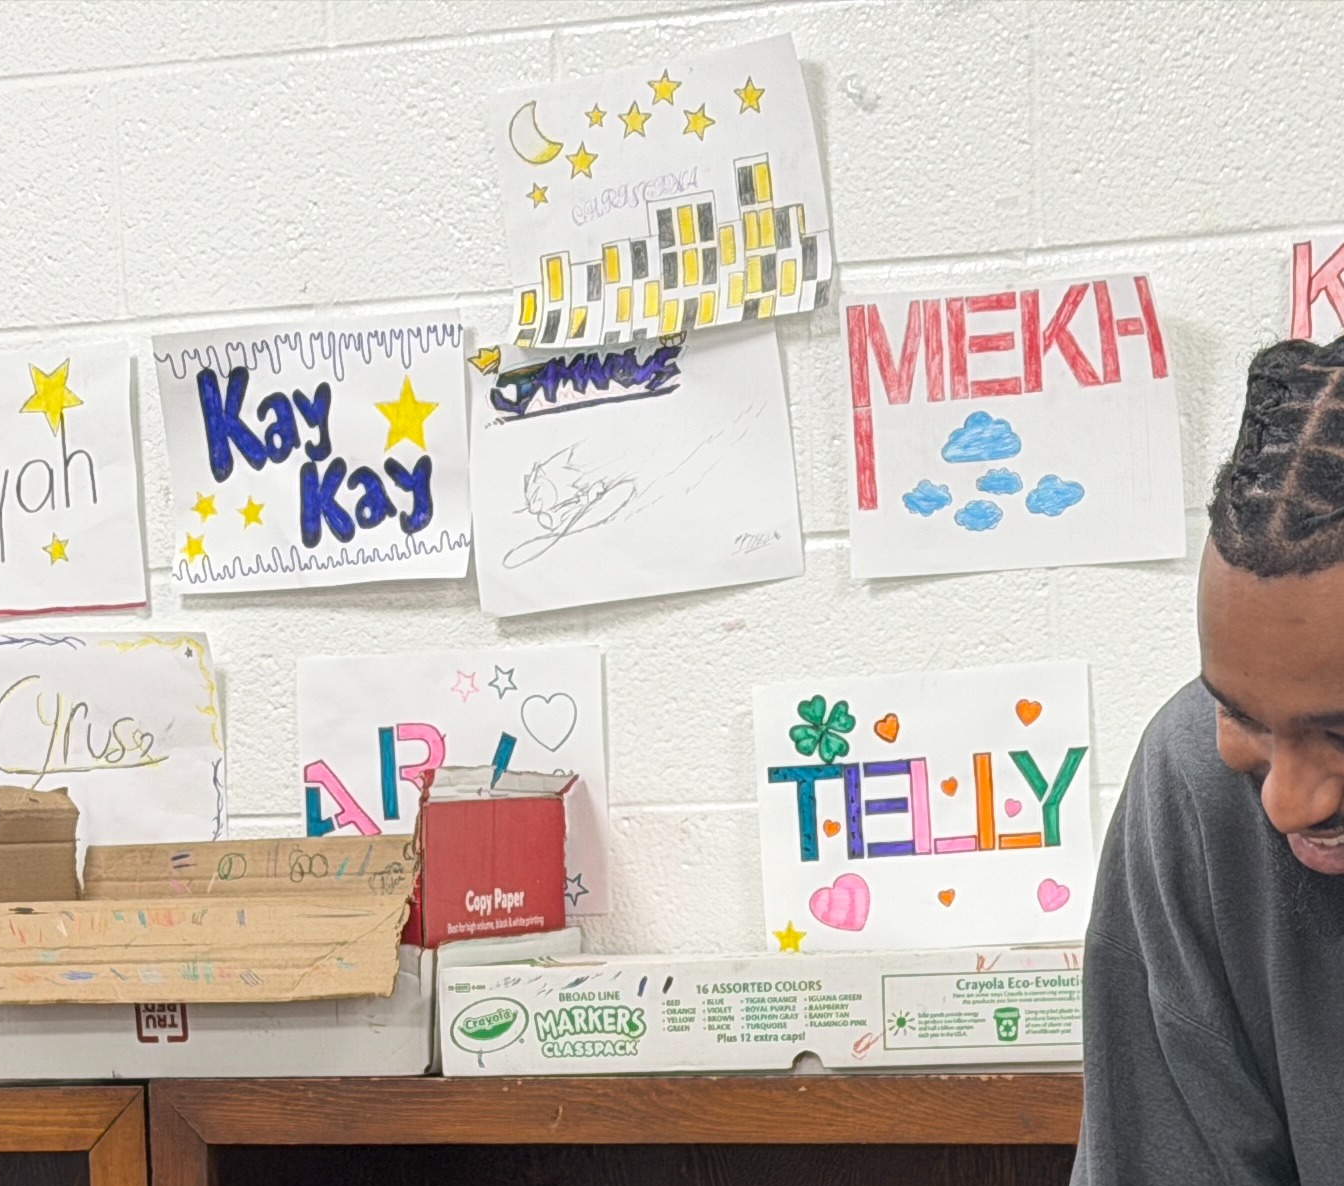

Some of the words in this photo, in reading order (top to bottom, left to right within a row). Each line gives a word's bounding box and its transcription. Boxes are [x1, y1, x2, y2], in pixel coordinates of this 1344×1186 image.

[196, 366, 333, 483] Kay
[300, 455, 434, 549] Kay
[767, 746, 1090, 863] TELLY
[465, 890, 492, 916] Copy
[494, 888, 525, 914] Paper
[696, 984, 709, 995] 16
[712, 981, 772, 994] ASSORTED
[775, 980, 822, 992] COLORS
[956, 976, 1005, 994] Crayola
[559, 992, 596, 1002] BROAD
[598, 991, 621, 1001] LINE
[465, 1009, 512, 1031] Crayola
[534, 1005, 646, 1042] MARKERS
[717, 1033, 738, 1043] Plus
[740, 1033, 751, 1043] 12
[753, 1033, 778, 1042] extra
[781, 1031, 806, 1044] caps!
[541, 1040, 638, 1058] CLASSPACK
